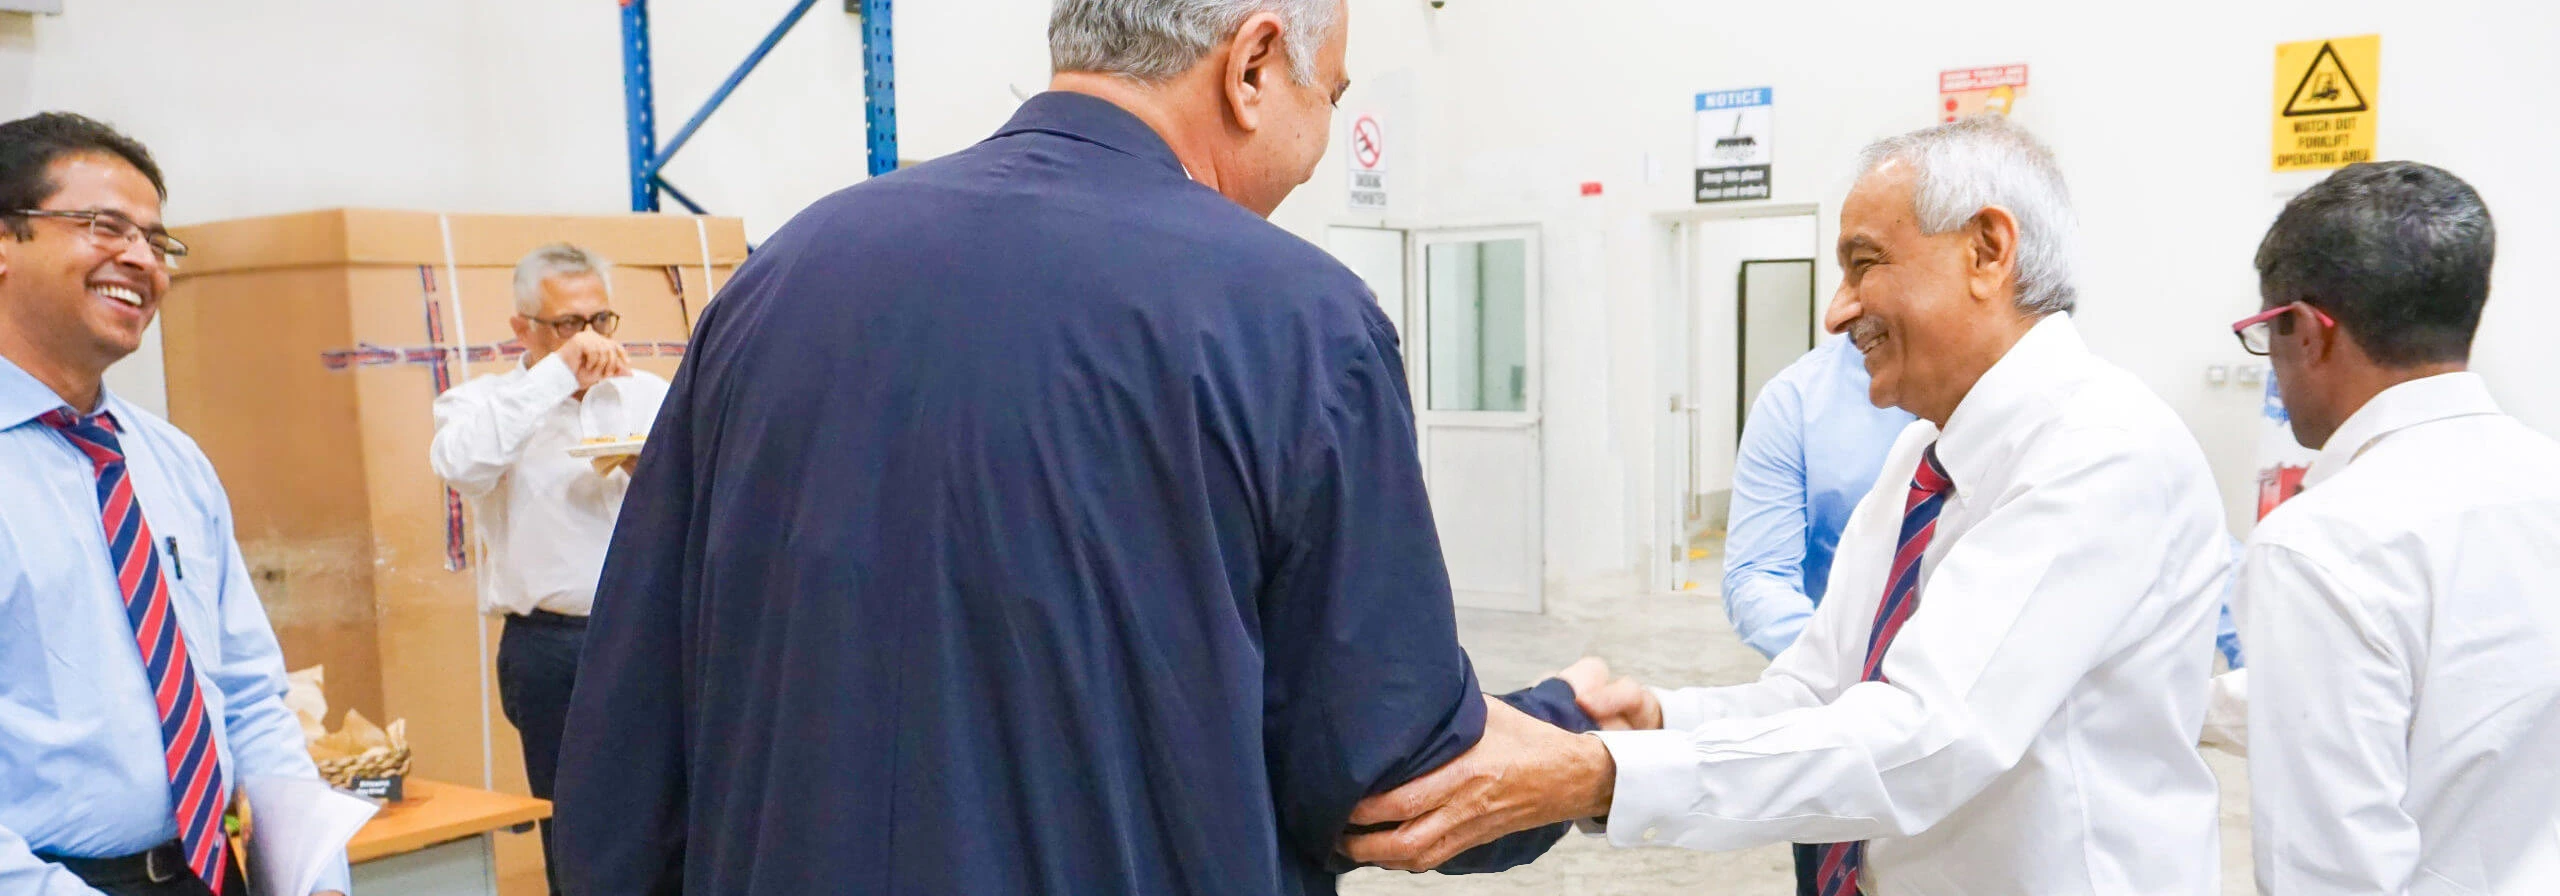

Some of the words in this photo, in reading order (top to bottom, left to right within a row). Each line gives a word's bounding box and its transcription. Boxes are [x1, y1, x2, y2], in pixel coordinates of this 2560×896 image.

[1705, 90, 1761, 108] NOTICE
[2336, 117, 2357, 130] OUT
[2297, 134, 2350, 149] FORKLIFT
